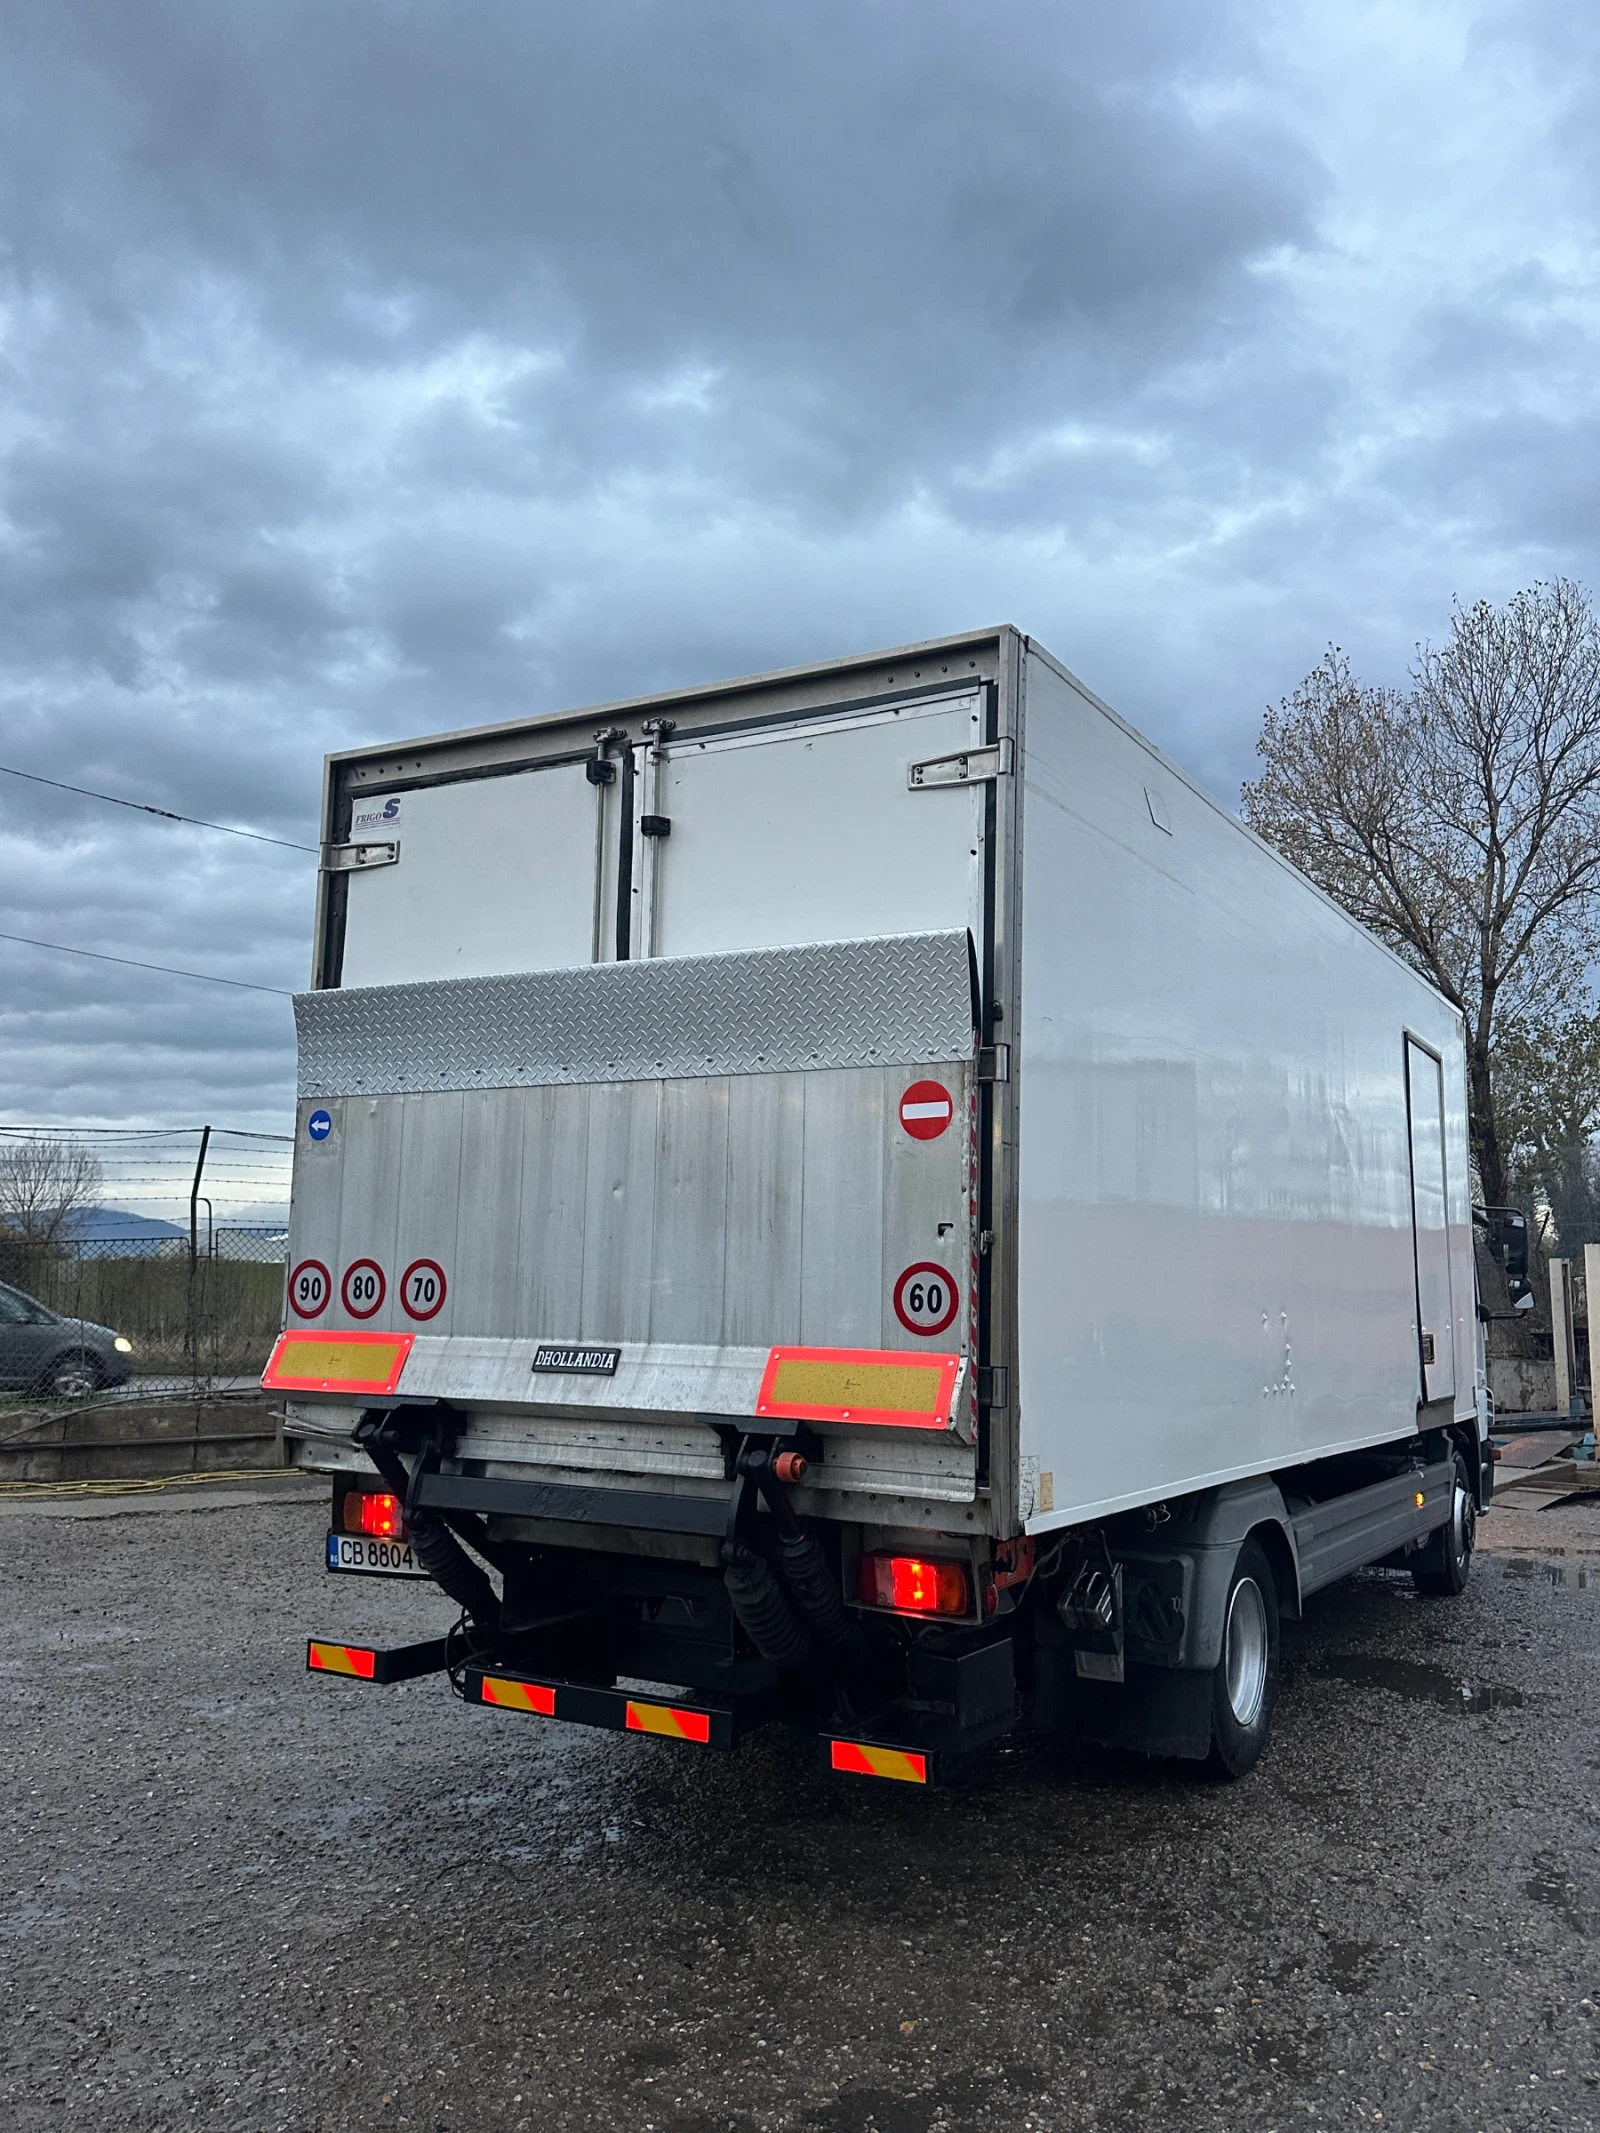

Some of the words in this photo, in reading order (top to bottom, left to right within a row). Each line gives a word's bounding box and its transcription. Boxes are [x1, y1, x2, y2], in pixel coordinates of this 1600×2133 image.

[355, 812, 382, 824] FRIGO
[299, 1277, 322, 1301] 90
[352, 1275, 375, 1300] 80
[413, 1277, 435, 1302] 70
[909, 1282, 942, 1314] 60
[535, 1350, 616, 1369] DHOLLANDIA
[341, 1540, 364, 1565] CB
[368, 1542, 414, 1570] 8804
